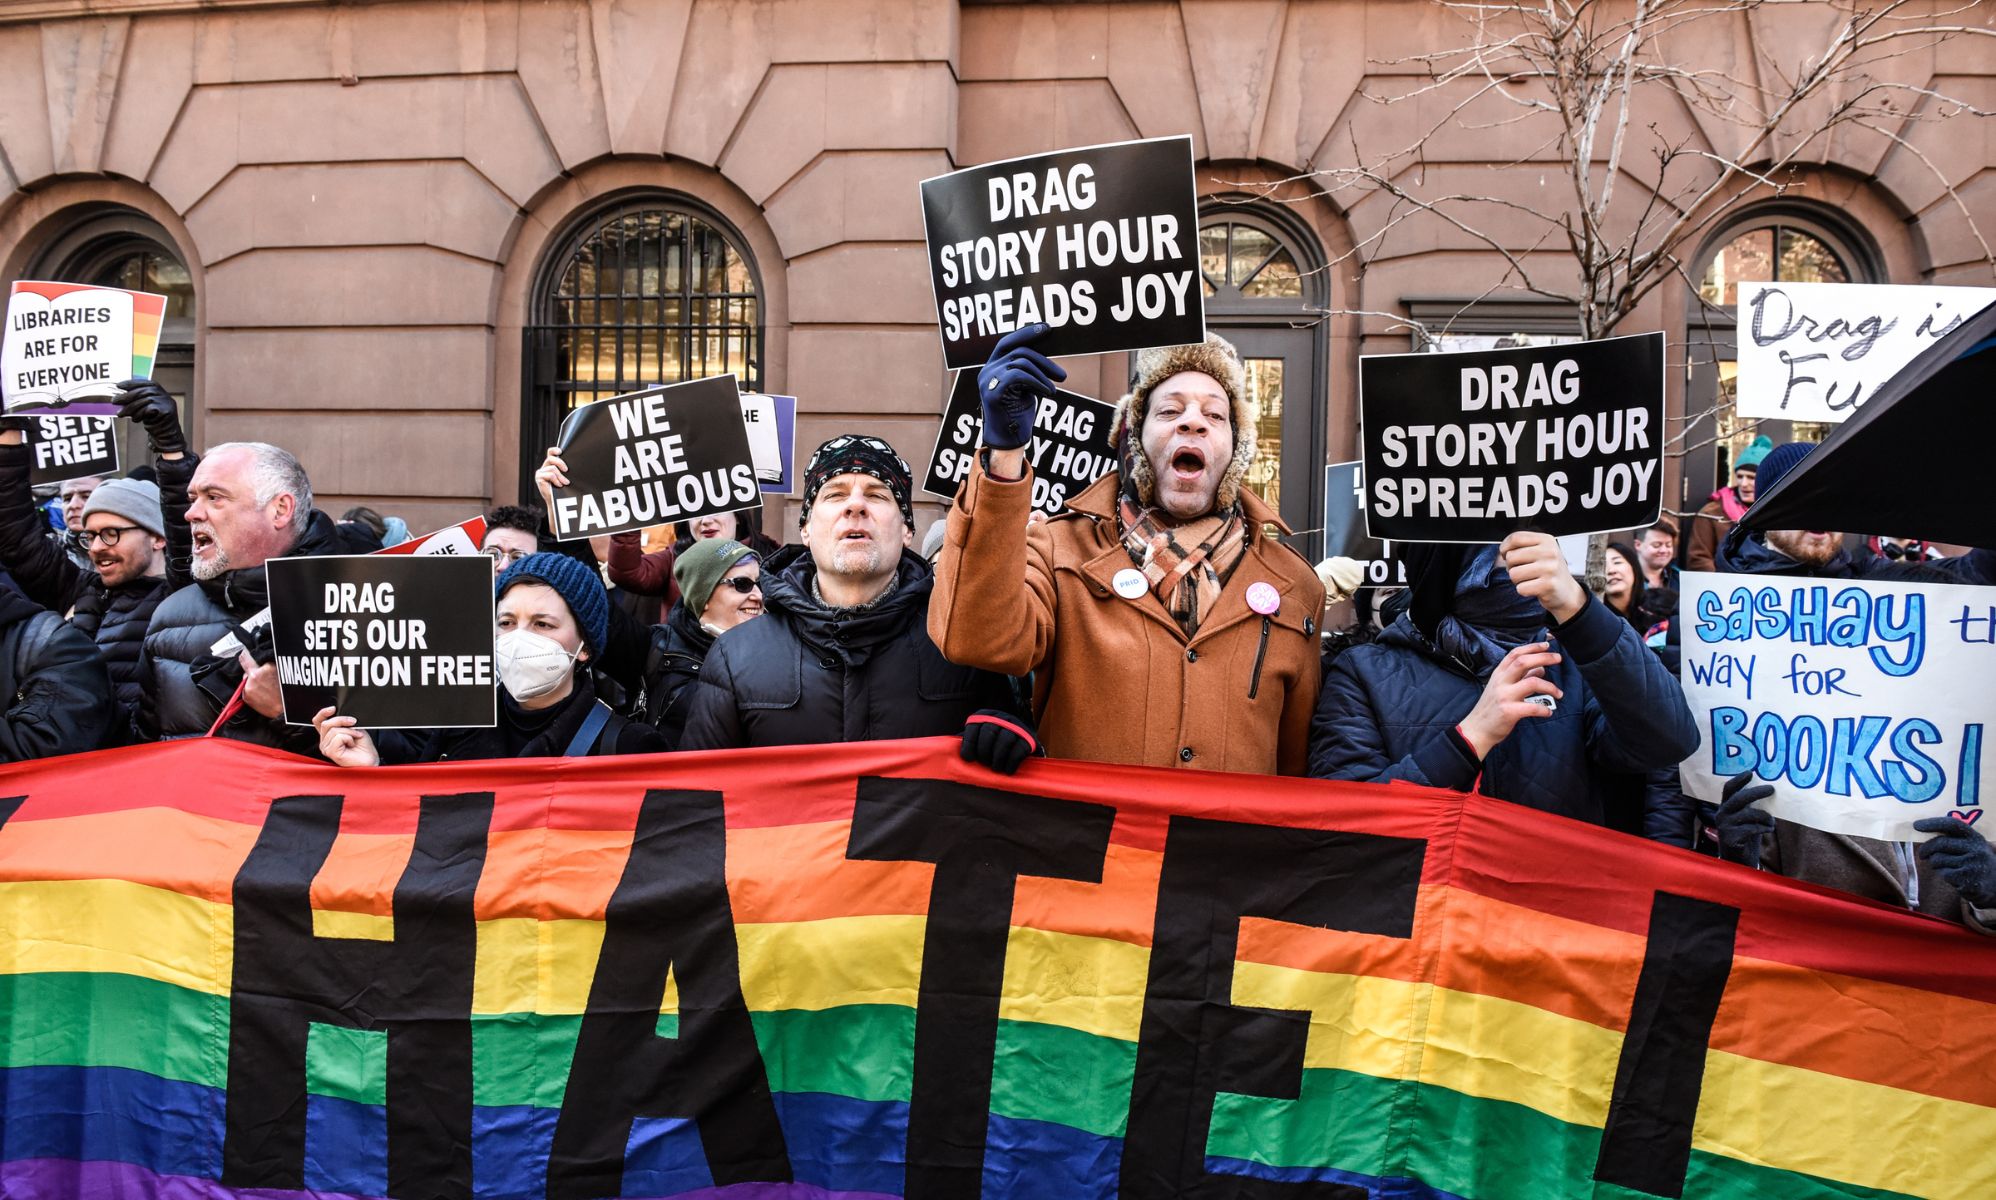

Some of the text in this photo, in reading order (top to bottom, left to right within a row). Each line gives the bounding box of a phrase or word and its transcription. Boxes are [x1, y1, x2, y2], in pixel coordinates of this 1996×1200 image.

[988, 163, 1097, 222] DRAG
[941, 214, 1183, 288] STORY HOUR
[14, 307, 111, 332] LIBRARIES
[943, 270, 1193, 342] SPREADS JOY
[1750, 287, 1899, 361] Drag
[24, 335, 98, 359] ARE FOR
[18, 362, 110, 389] EVERYONE
[1461, 359, 1580, 412] DRAG
[1779, 350, 1888, 411] Fu
[39, 416, 112, 440] SETS
[607, 394, 671, 441] WE
[953, 413, 1052, 468] STY
[1034, 397, 1095, 442] RAG
[1382, 406, 1650, 468] STORY HOUR
[35, 432, 108, 469] FREE
[614, 434, 689, 484] ARE
[556, 464, 756, 534] FABULOUS
[1374, 471, 1569, 519] SPREADS
[1580, 459, 1658, 509] JOY
[325, 582, 395, 613] DRAG
[304, 619, 358, 650] SETS
[366, 619, 427, 650] OUR
[278, 655, 491, 687] IMAGINATION FREE
[1710, 706, 1984, 827] BOOKS!
